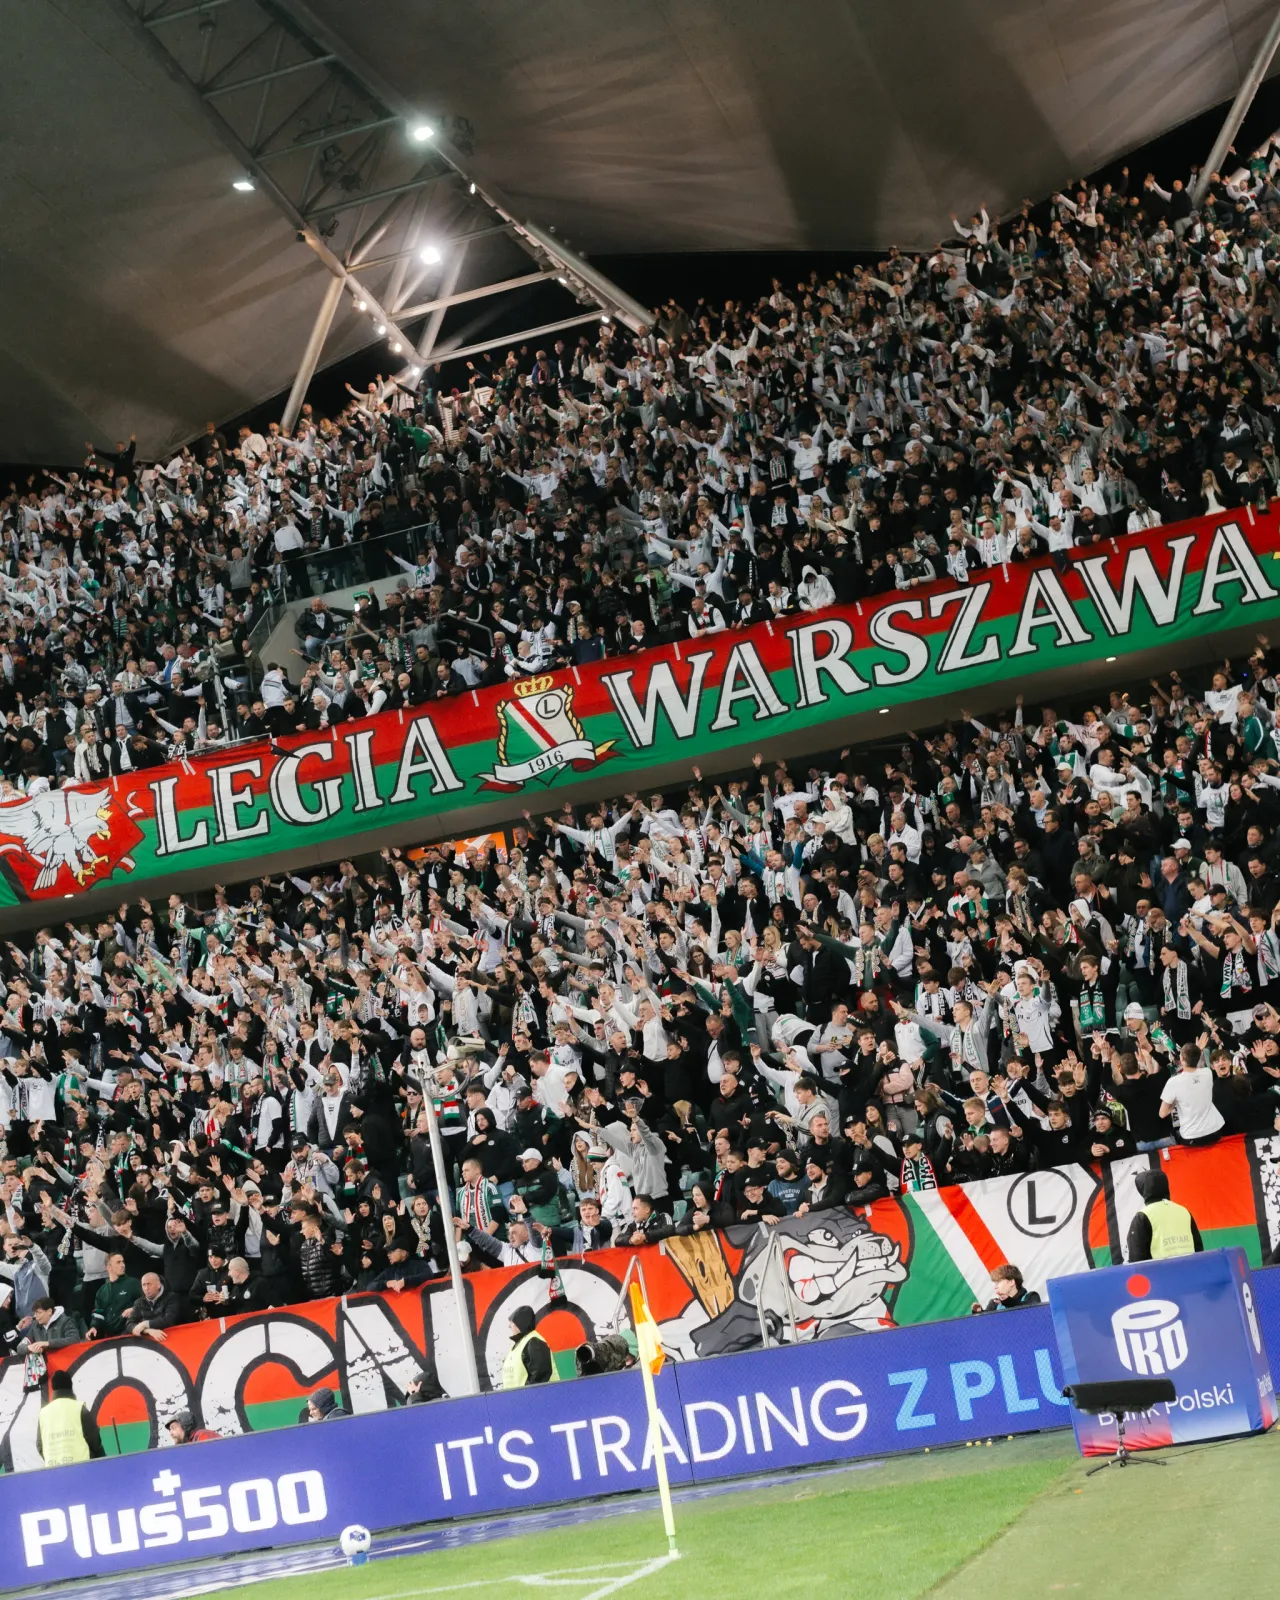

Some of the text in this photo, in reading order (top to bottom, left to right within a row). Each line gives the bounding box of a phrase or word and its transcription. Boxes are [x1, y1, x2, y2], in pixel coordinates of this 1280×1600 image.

[149, 521, 1280, 857] LEGIA WARSZAWA
[527, 749, 564, 775] 1916
[435, 1425, 540, 1500] IT'S
[550, 1379, 868, 1481] TRADING
[888, 1367, 936, 1431] Z
[1164, 1383, 1234, 1415] Polski
[20, 1469, 328, 1567] Plus500
